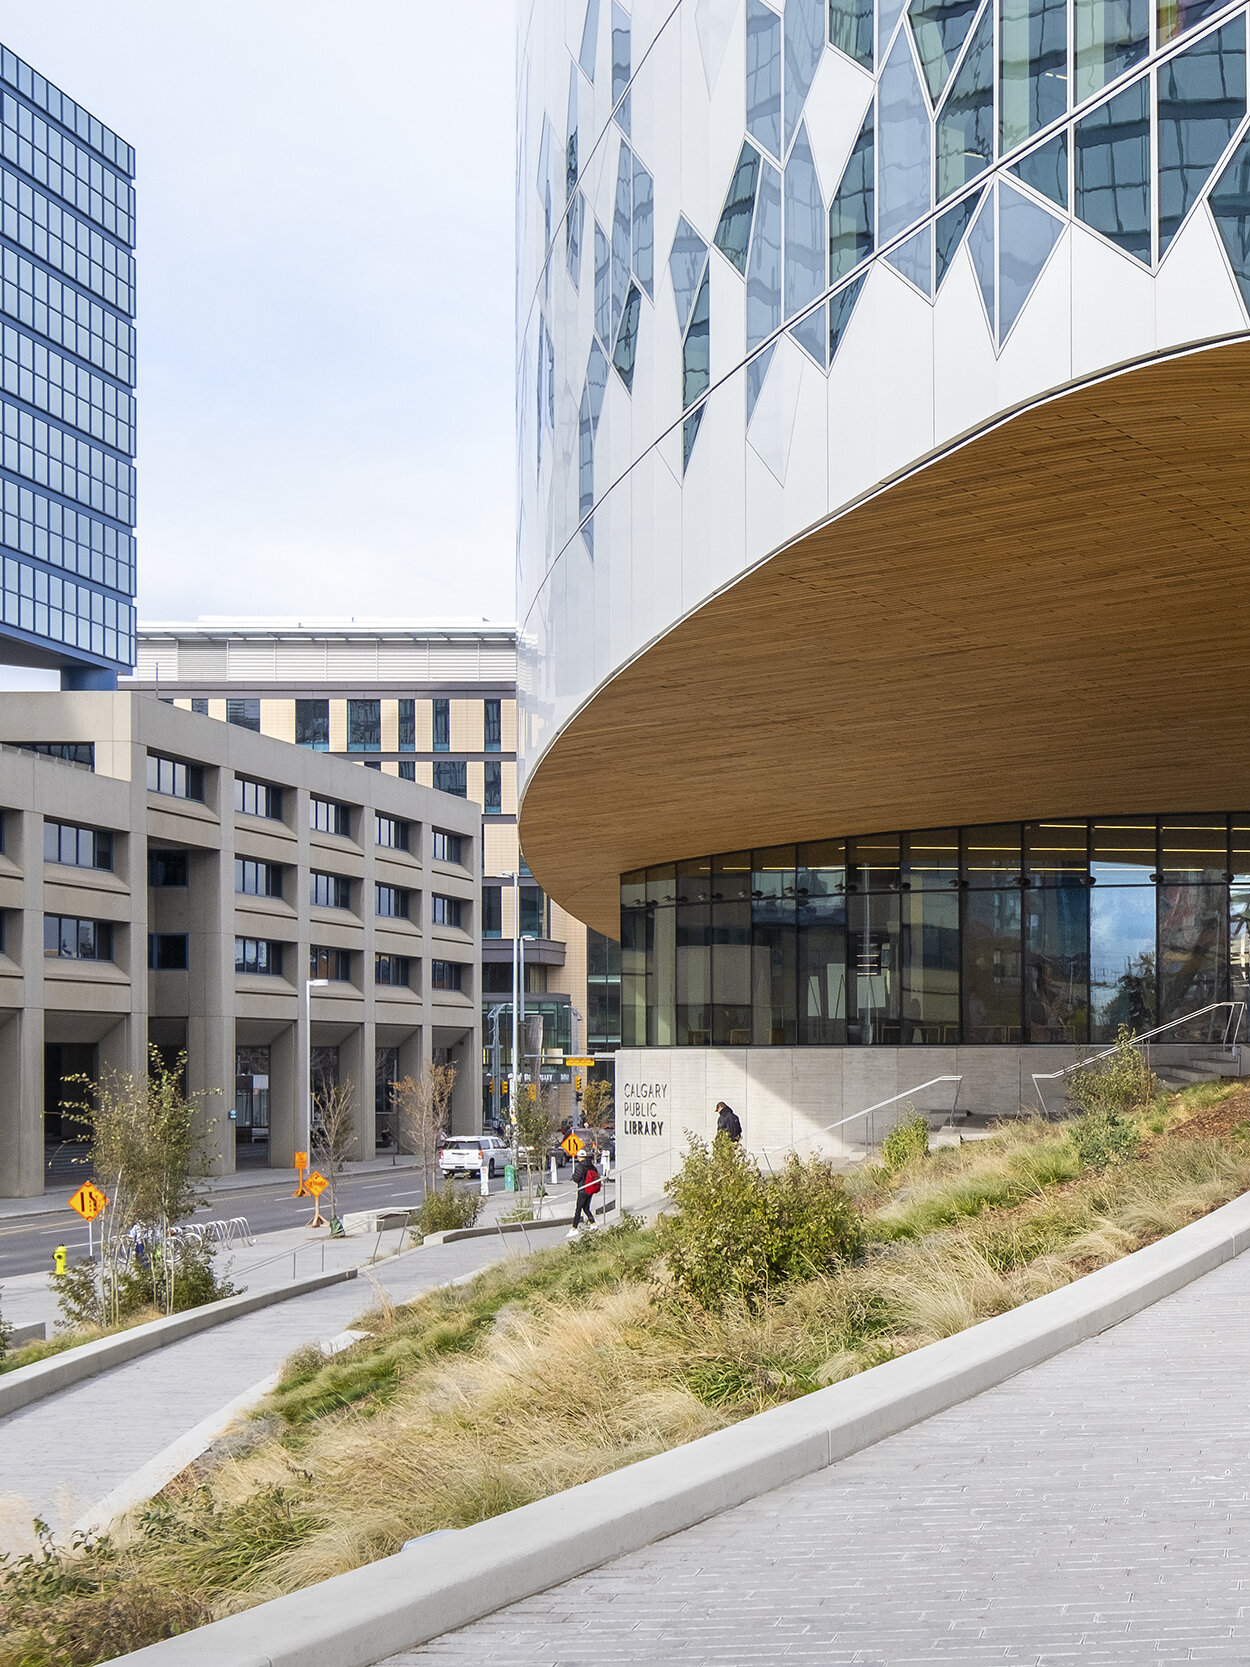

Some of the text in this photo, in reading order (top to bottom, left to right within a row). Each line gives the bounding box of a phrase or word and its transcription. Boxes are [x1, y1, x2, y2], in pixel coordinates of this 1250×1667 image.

[624, 1083, 667, 1098] CALGARY
[624, 1102, 657, 1118] PUBLIC
[624, 1120, 664, 1136] LIBRARY
